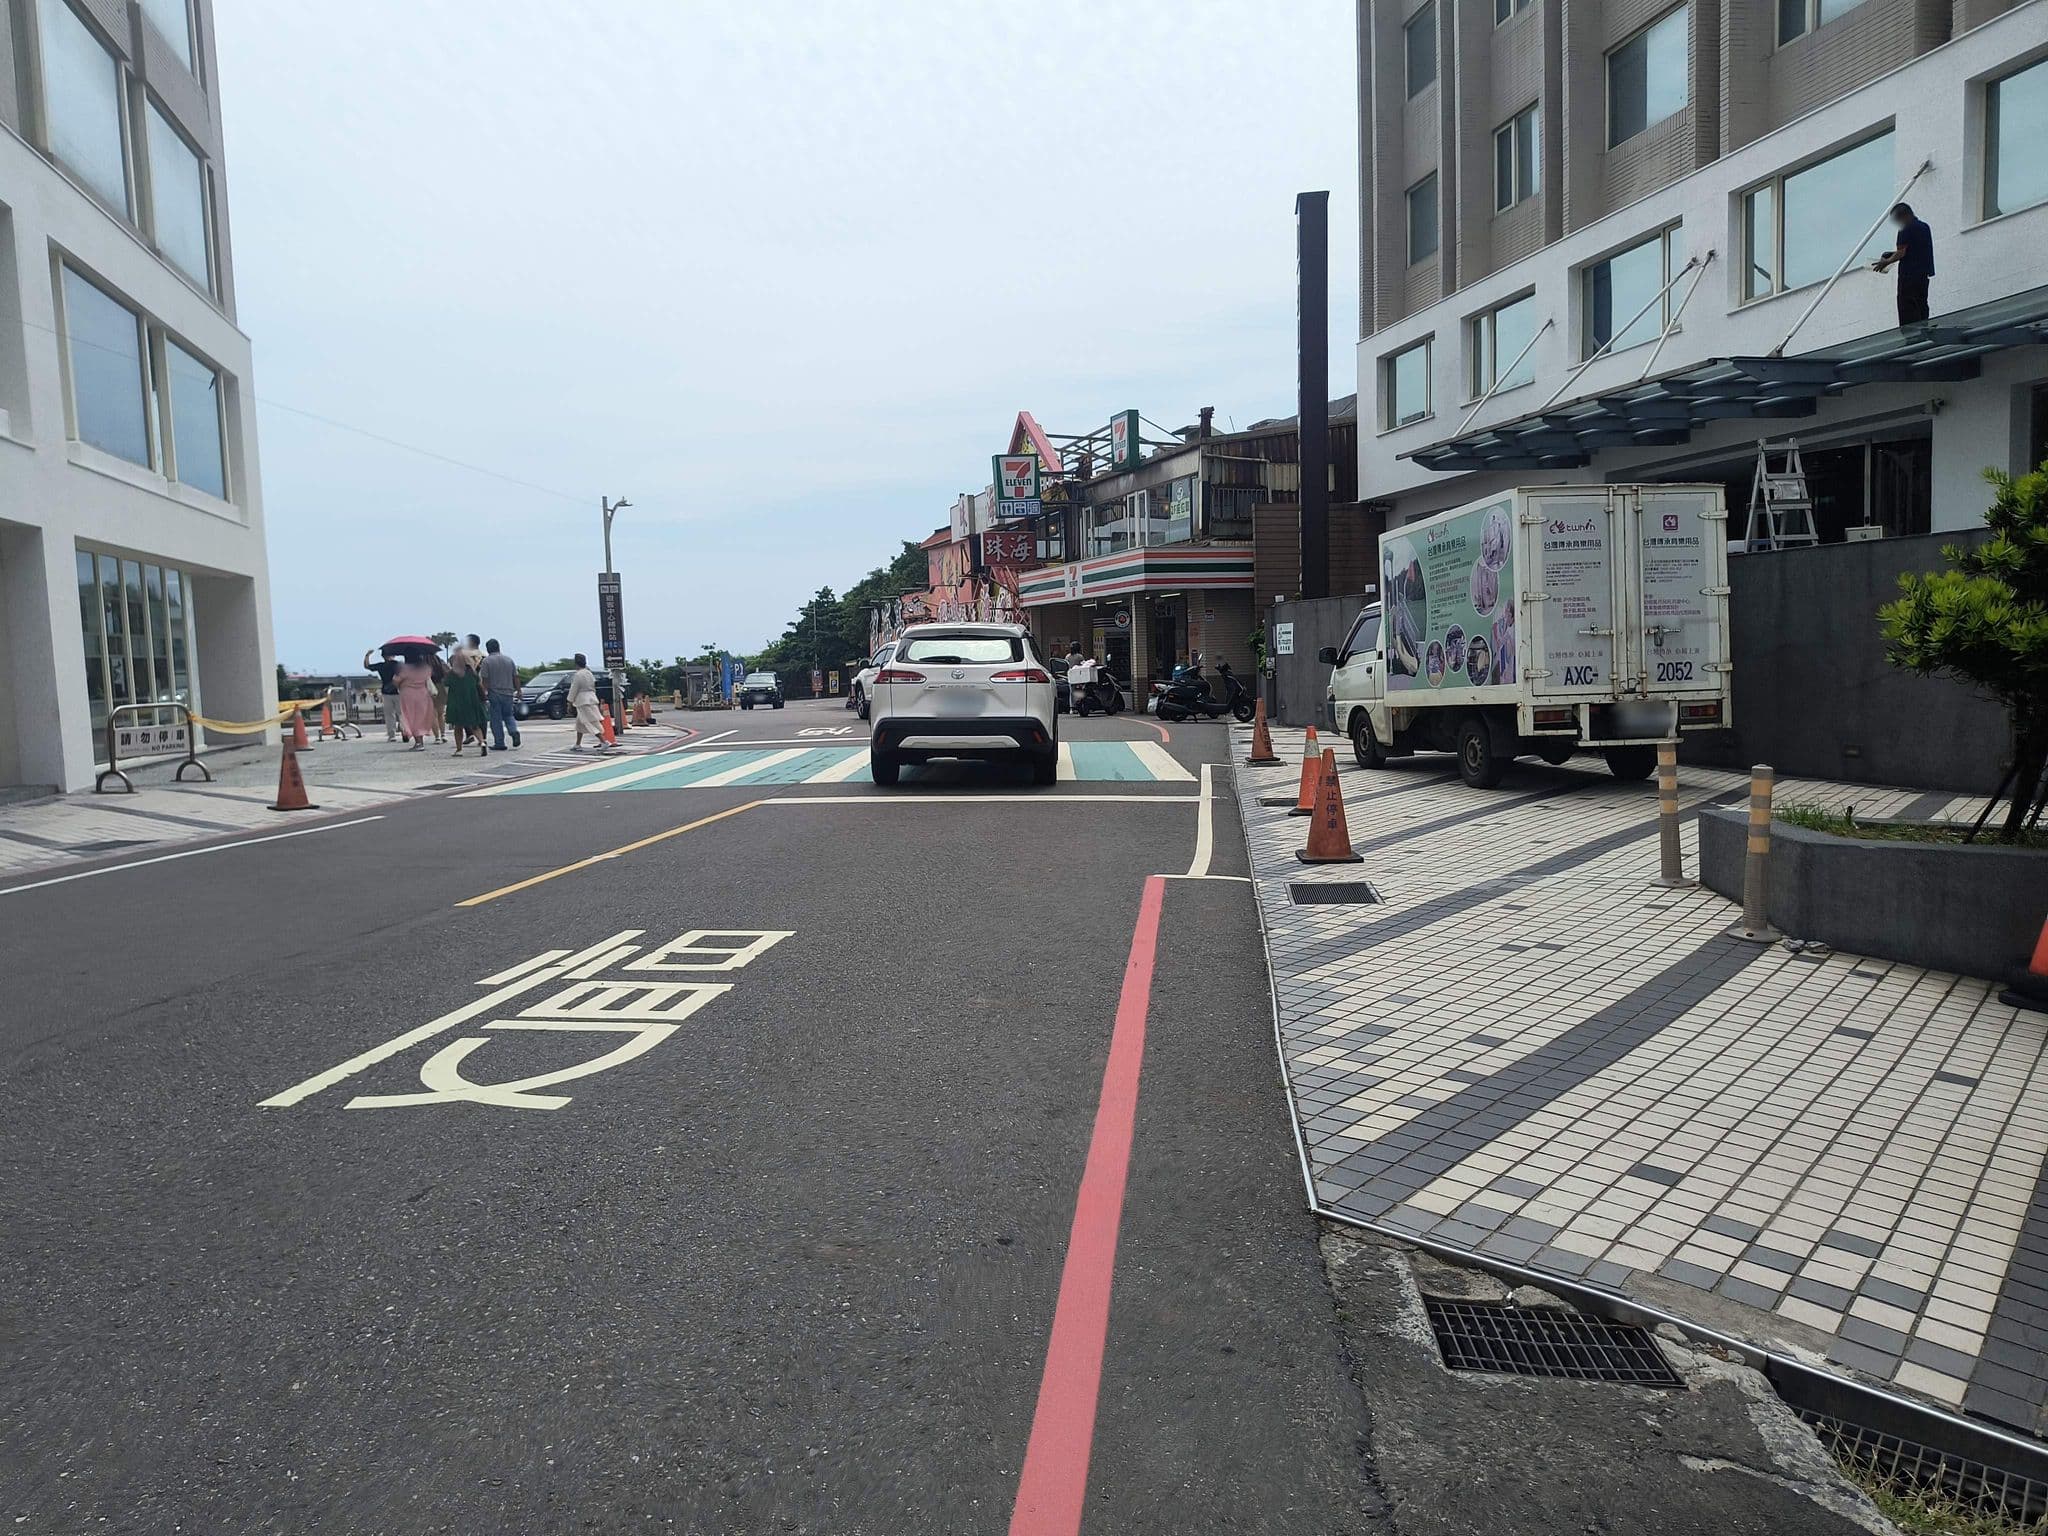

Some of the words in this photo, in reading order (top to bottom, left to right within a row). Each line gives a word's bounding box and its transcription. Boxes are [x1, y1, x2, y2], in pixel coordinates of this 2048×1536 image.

[986, 534, 1032, 563] 珠海
[1564, 665, 1599, 686] AXC-
[1656, 661, 1693, 682] 2052
[161, 743, 185, 751] PARKING
[1326, 775, 1337, 829] 禁止停車
[256, 929, 797, 1110] 慢
